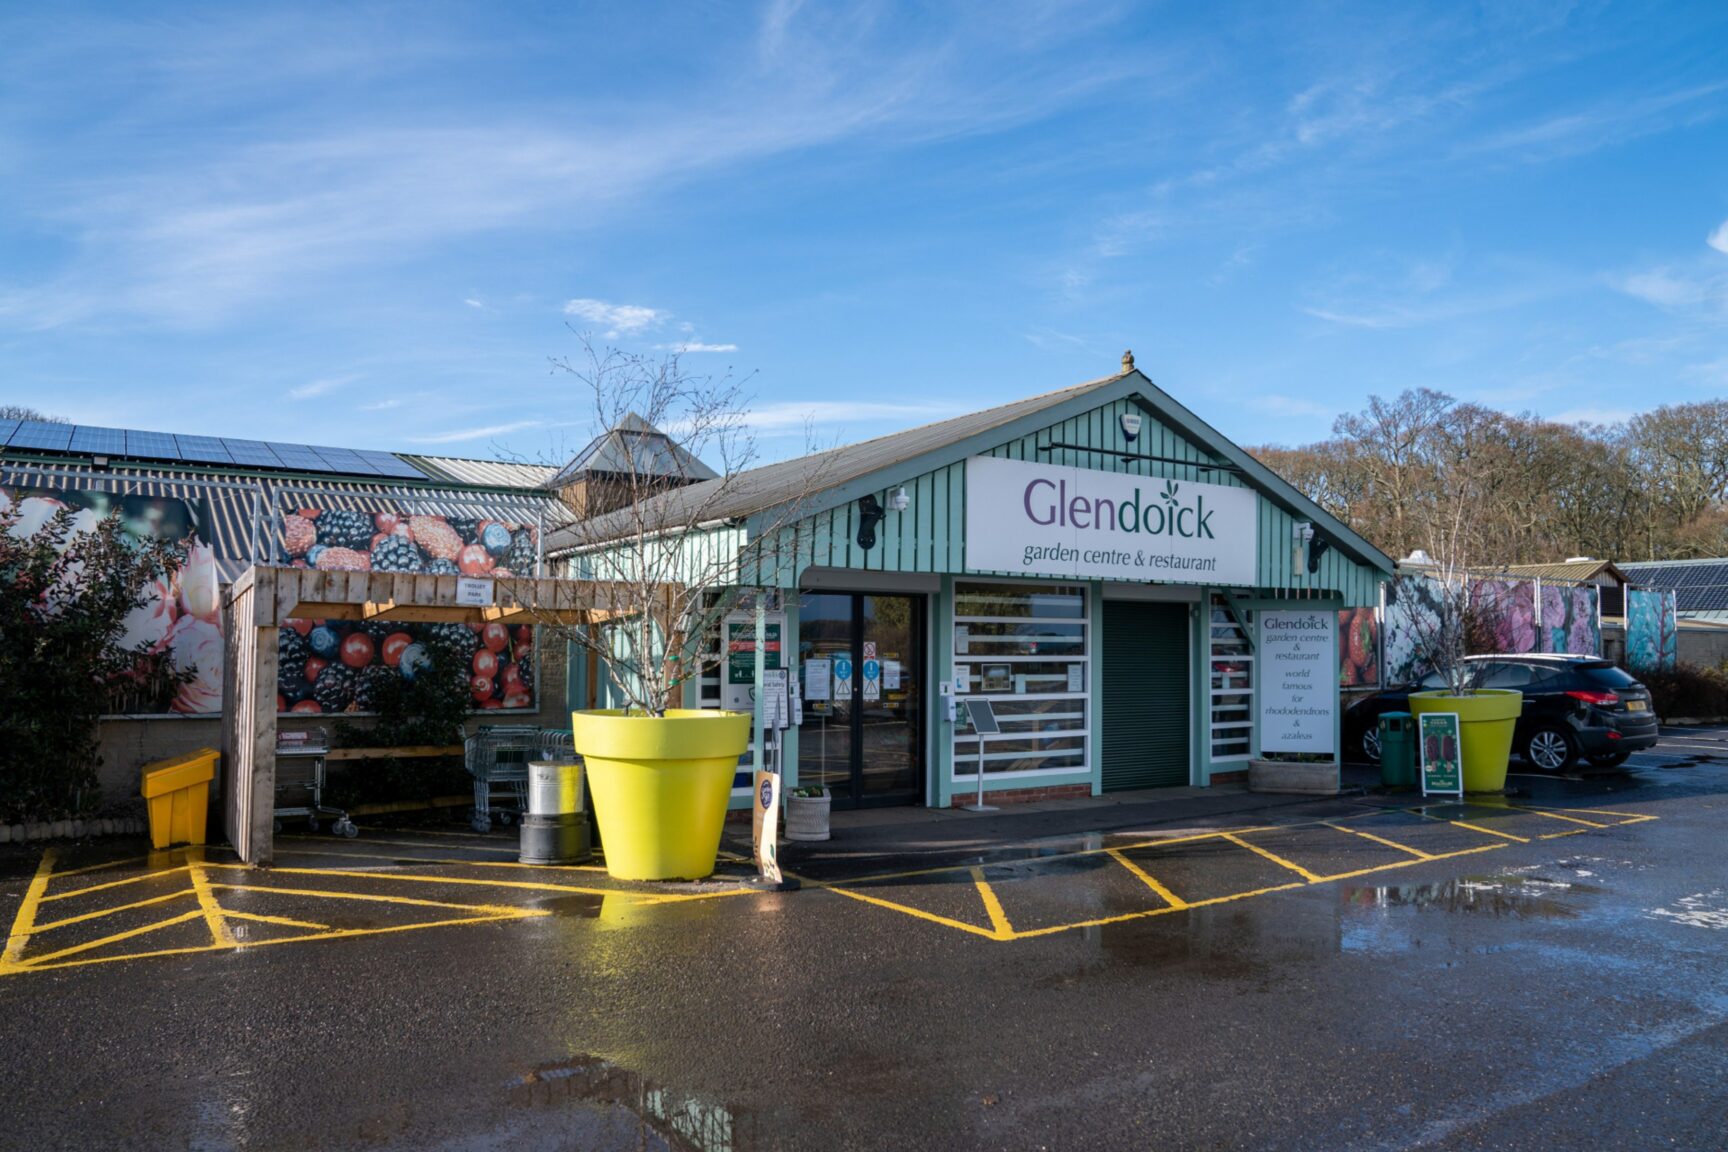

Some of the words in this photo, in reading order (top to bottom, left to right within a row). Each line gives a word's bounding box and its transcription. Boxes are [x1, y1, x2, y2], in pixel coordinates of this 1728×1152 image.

[1023, 478, 1215, 539] Glendoick
[1023, 542, 1079, 565] garden
[1083, 549, 1131, 566] centre
[1134, 550, 1146, 567] &
[1149, 553, 1216, 571] restaurant
[1264, 615, 1328, 630] Glendoick
[1265, 633, 1298, 644] garden
[1293, 643, 1300, 651] &
[1275, 652, 1320, 660] restaurant
[1285, 669, 1310, 677] world
[1281, 682, 1313, 690] famous
[1265, 707, 1329, 715] rhododendrons
[1281, 731, 1313, 740] azaleas
